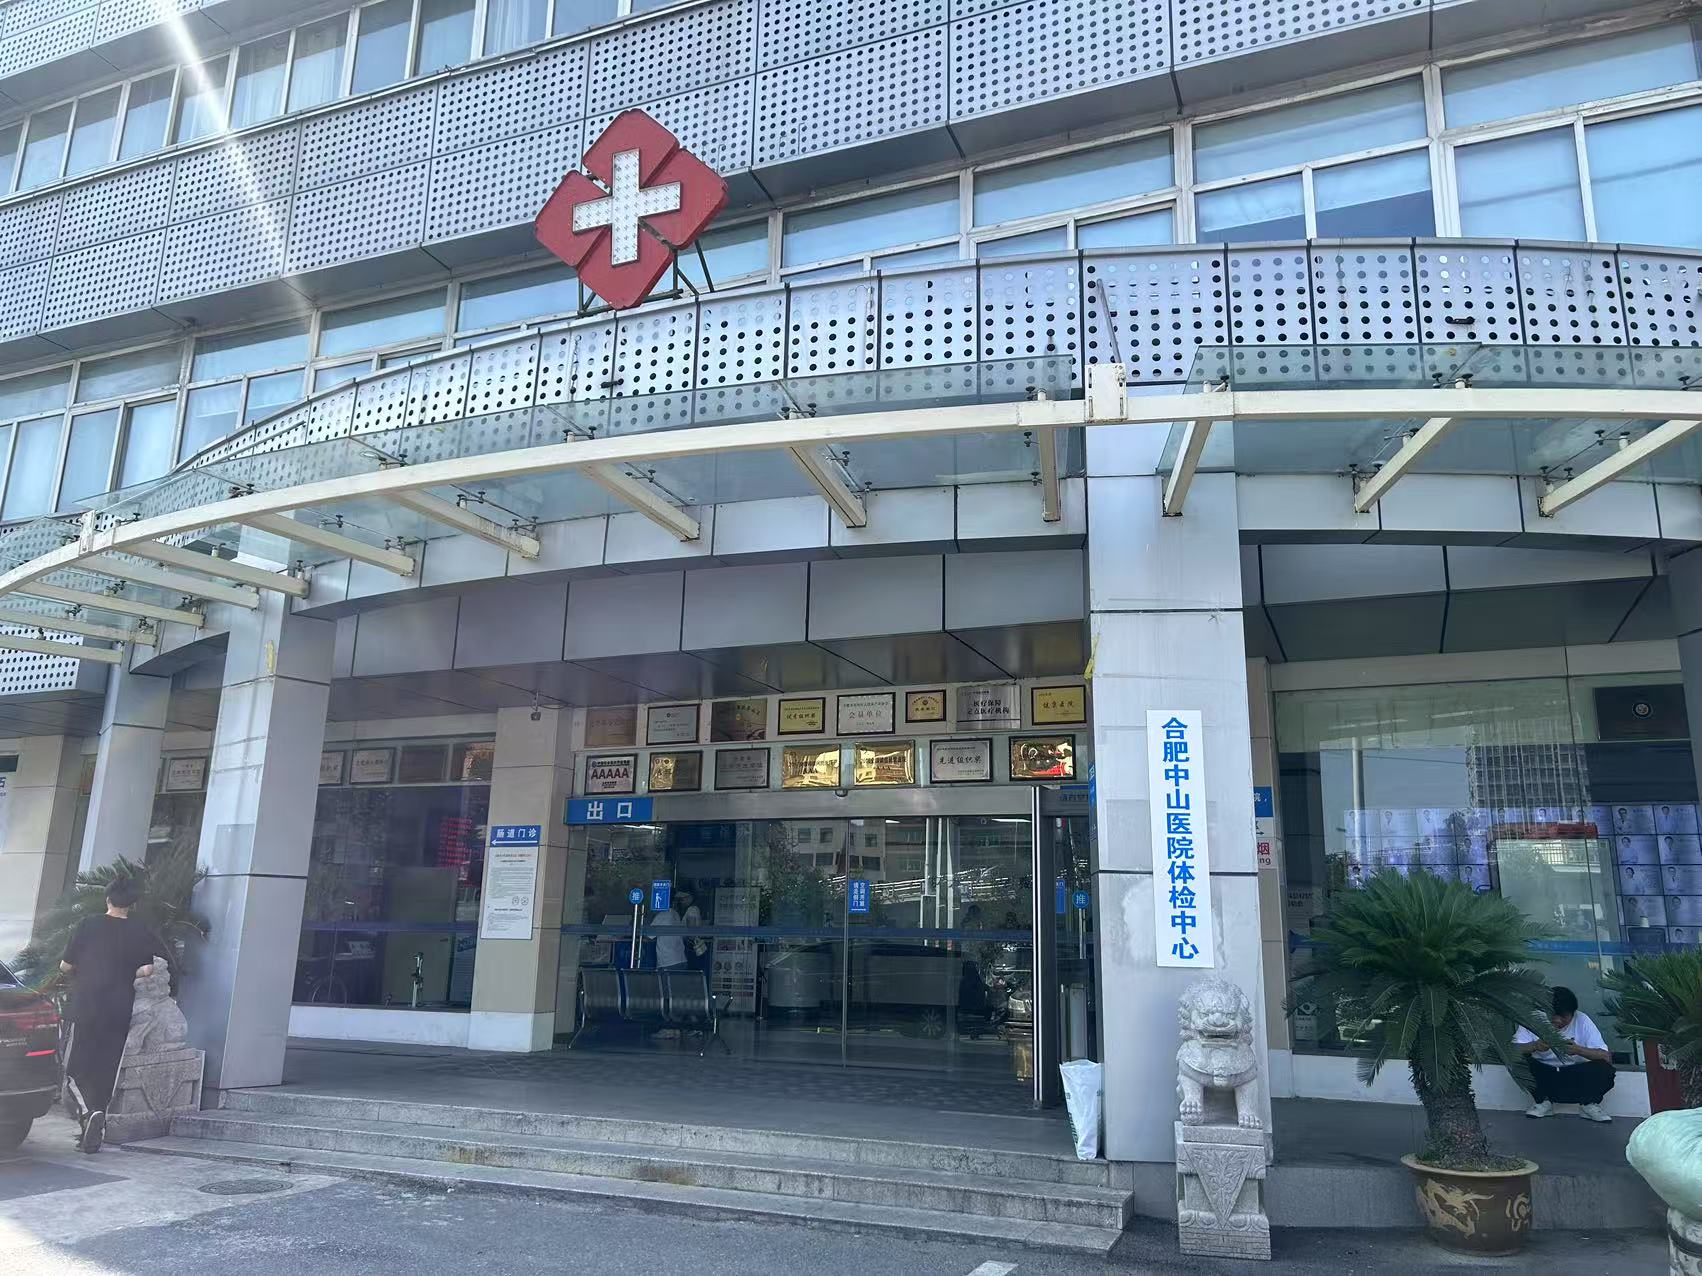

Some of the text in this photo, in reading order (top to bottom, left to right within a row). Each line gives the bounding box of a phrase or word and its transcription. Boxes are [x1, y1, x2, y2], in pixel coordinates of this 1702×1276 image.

[591, 767, 630, 780] AAAAA
[586, 800, 633, 821] 出口
[496, 828, 537, 838] 肠道门诊
[1161, 716, 1201, 960] 合肥中山医院体检中心
[631, 891, 641, 901] 推
[1075, 894, 1086, 904] 推
